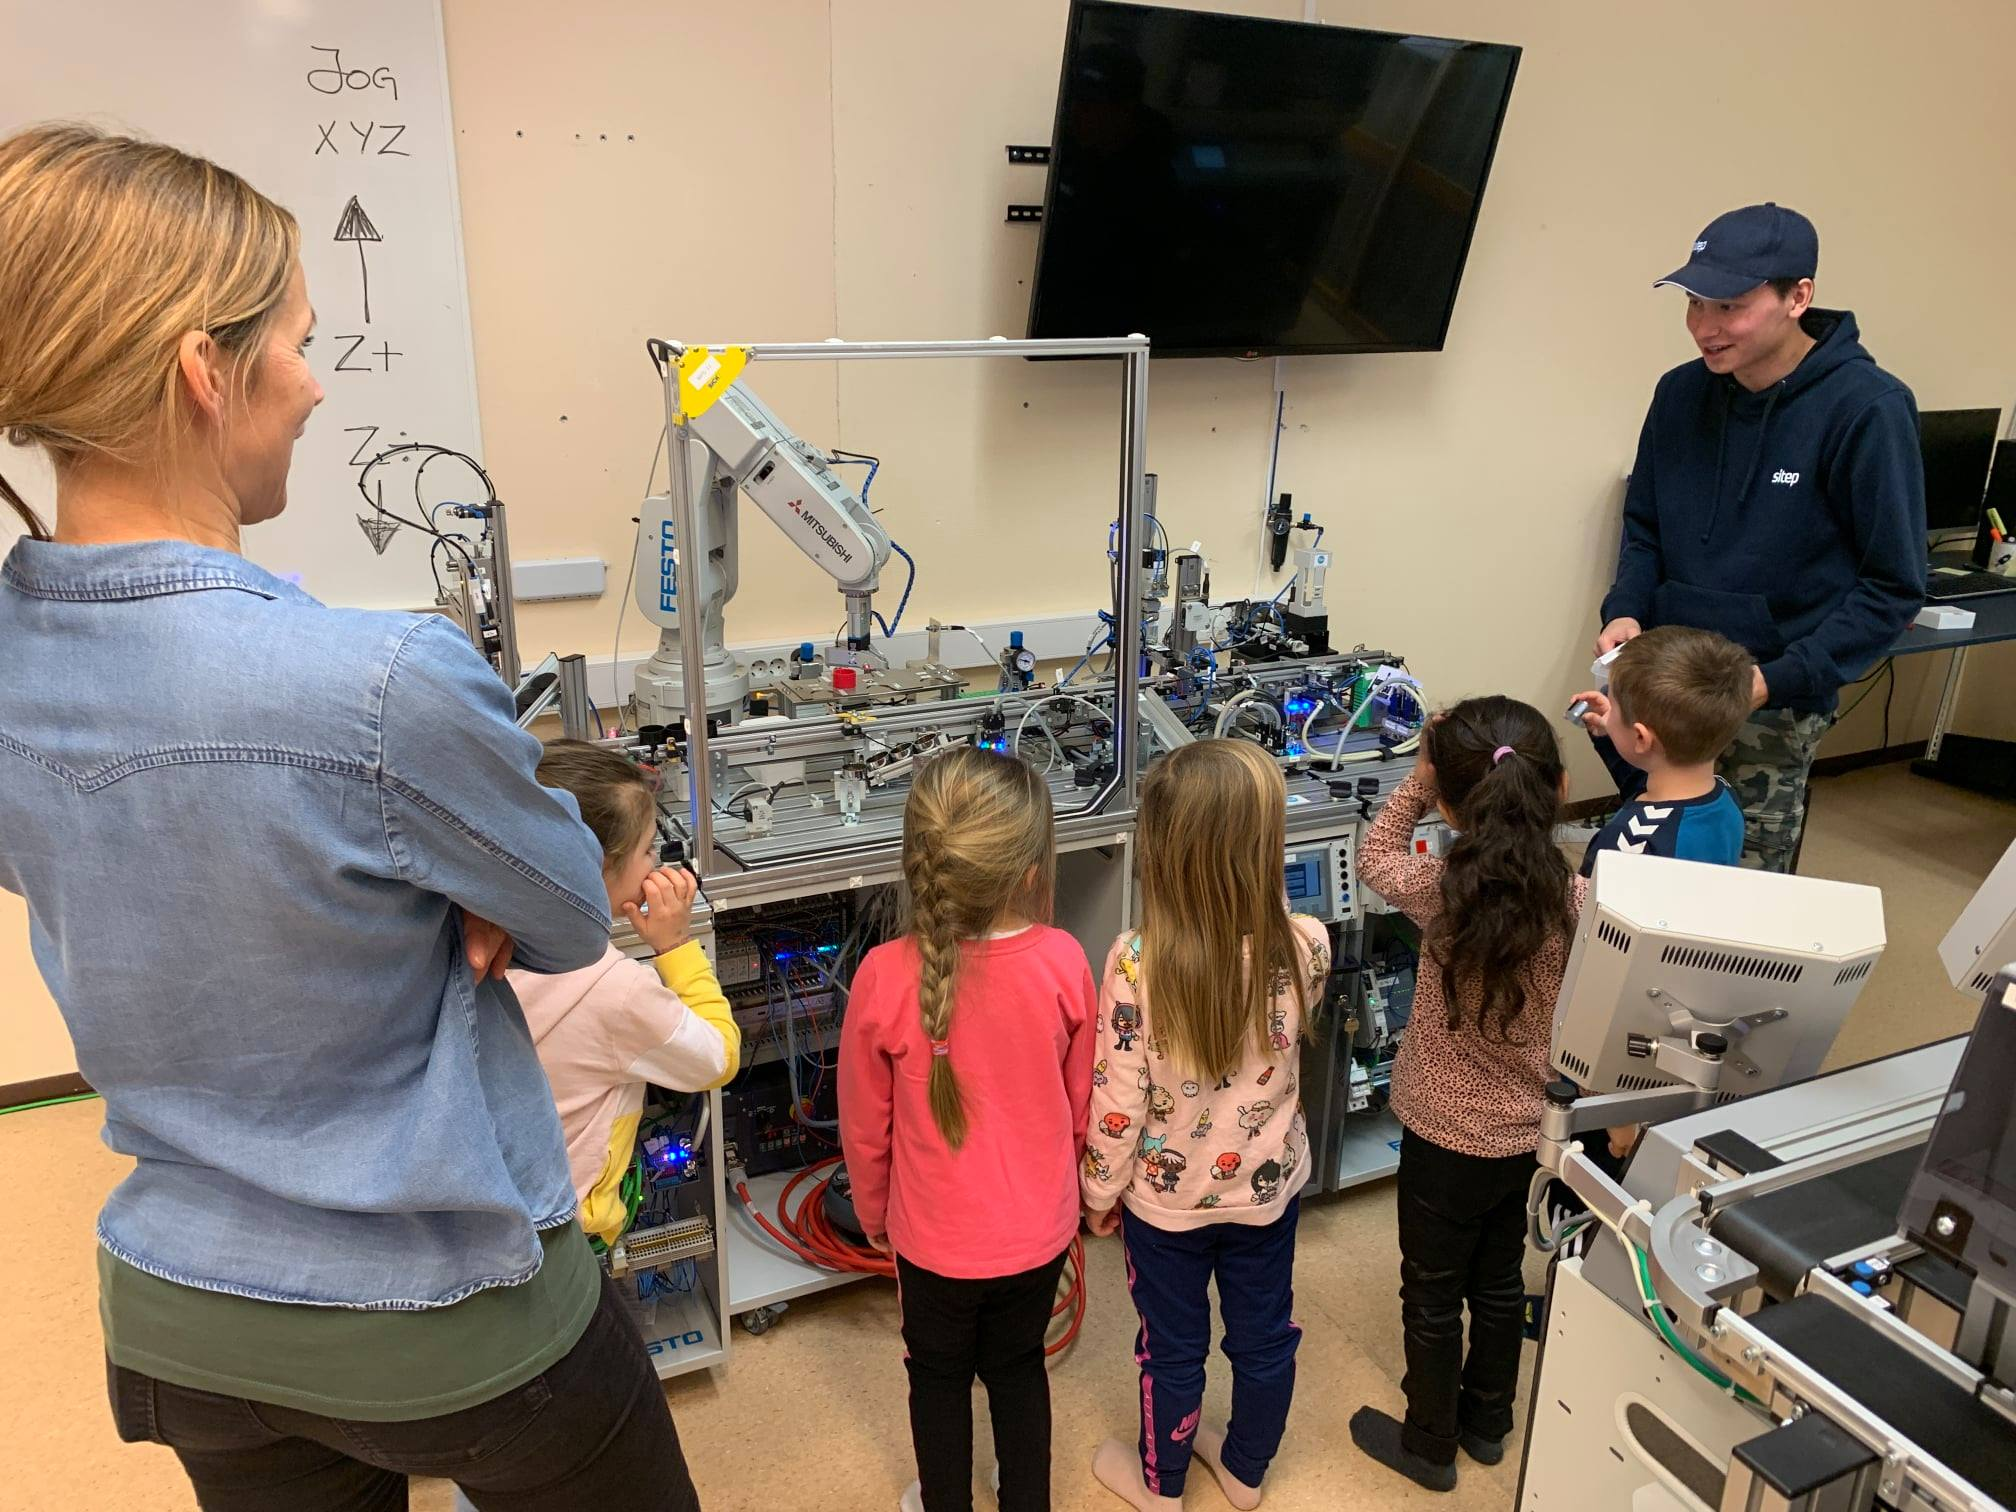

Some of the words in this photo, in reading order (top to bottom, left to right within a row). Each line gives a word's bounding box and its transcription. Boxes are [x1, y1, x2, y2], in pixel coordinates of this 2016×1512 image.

[1771, 468, 1800, 487] sitep
[801, 510, 853, 563] MITSUBISHI
[660, 520, 677, 612] FESTO
[646, 1330, 704, 1355] STO
